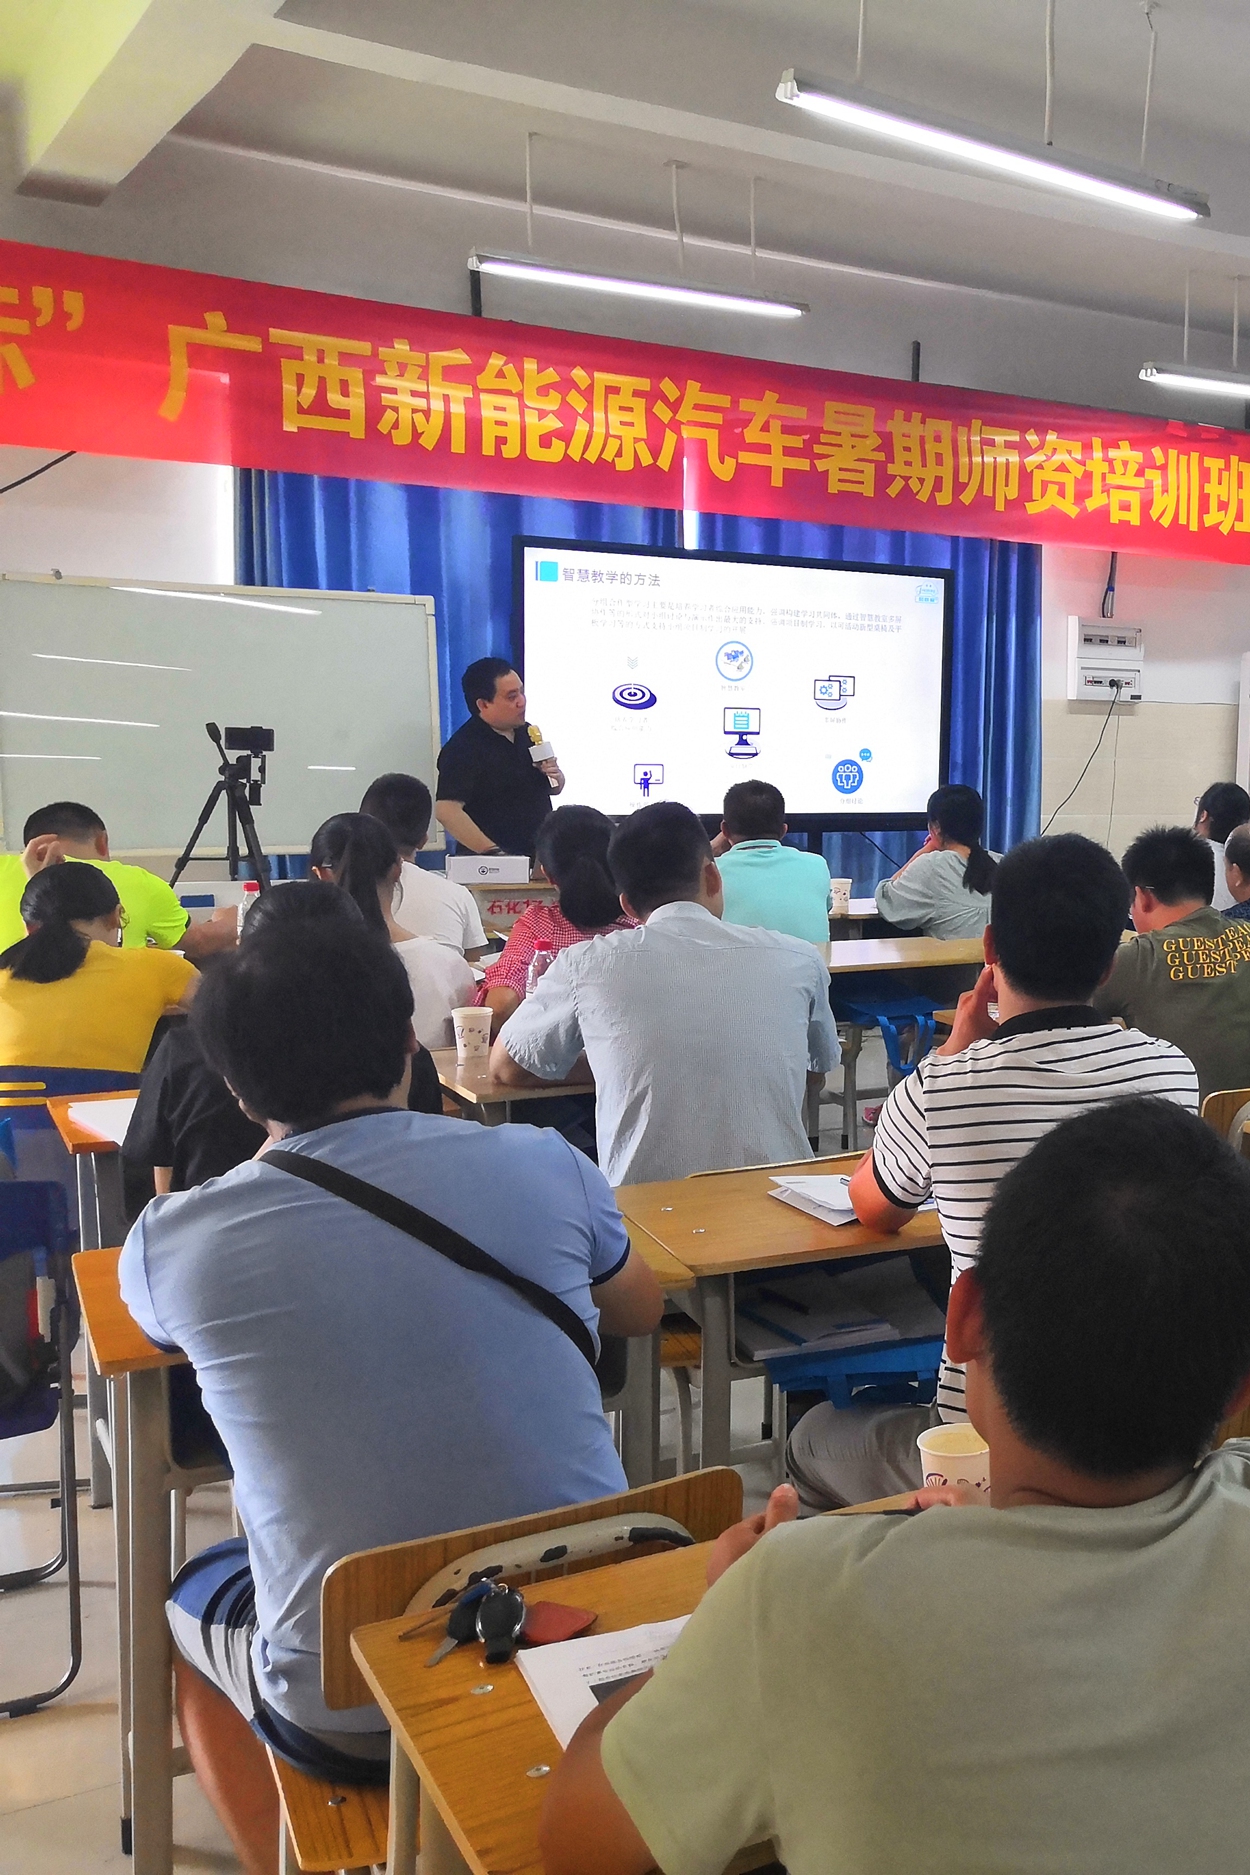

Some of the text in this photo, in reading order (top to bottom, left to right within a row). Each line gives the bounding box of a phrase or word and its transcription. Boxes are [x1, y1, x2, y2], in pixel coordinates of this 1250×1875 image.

[562, 567, 660, 587] 智慧教学的方法
[1163, 934, 1226, 952] GUEST
[1166, 947, 1231, 966] GUEST
[1169, 960, 1238, 981] GUEST
